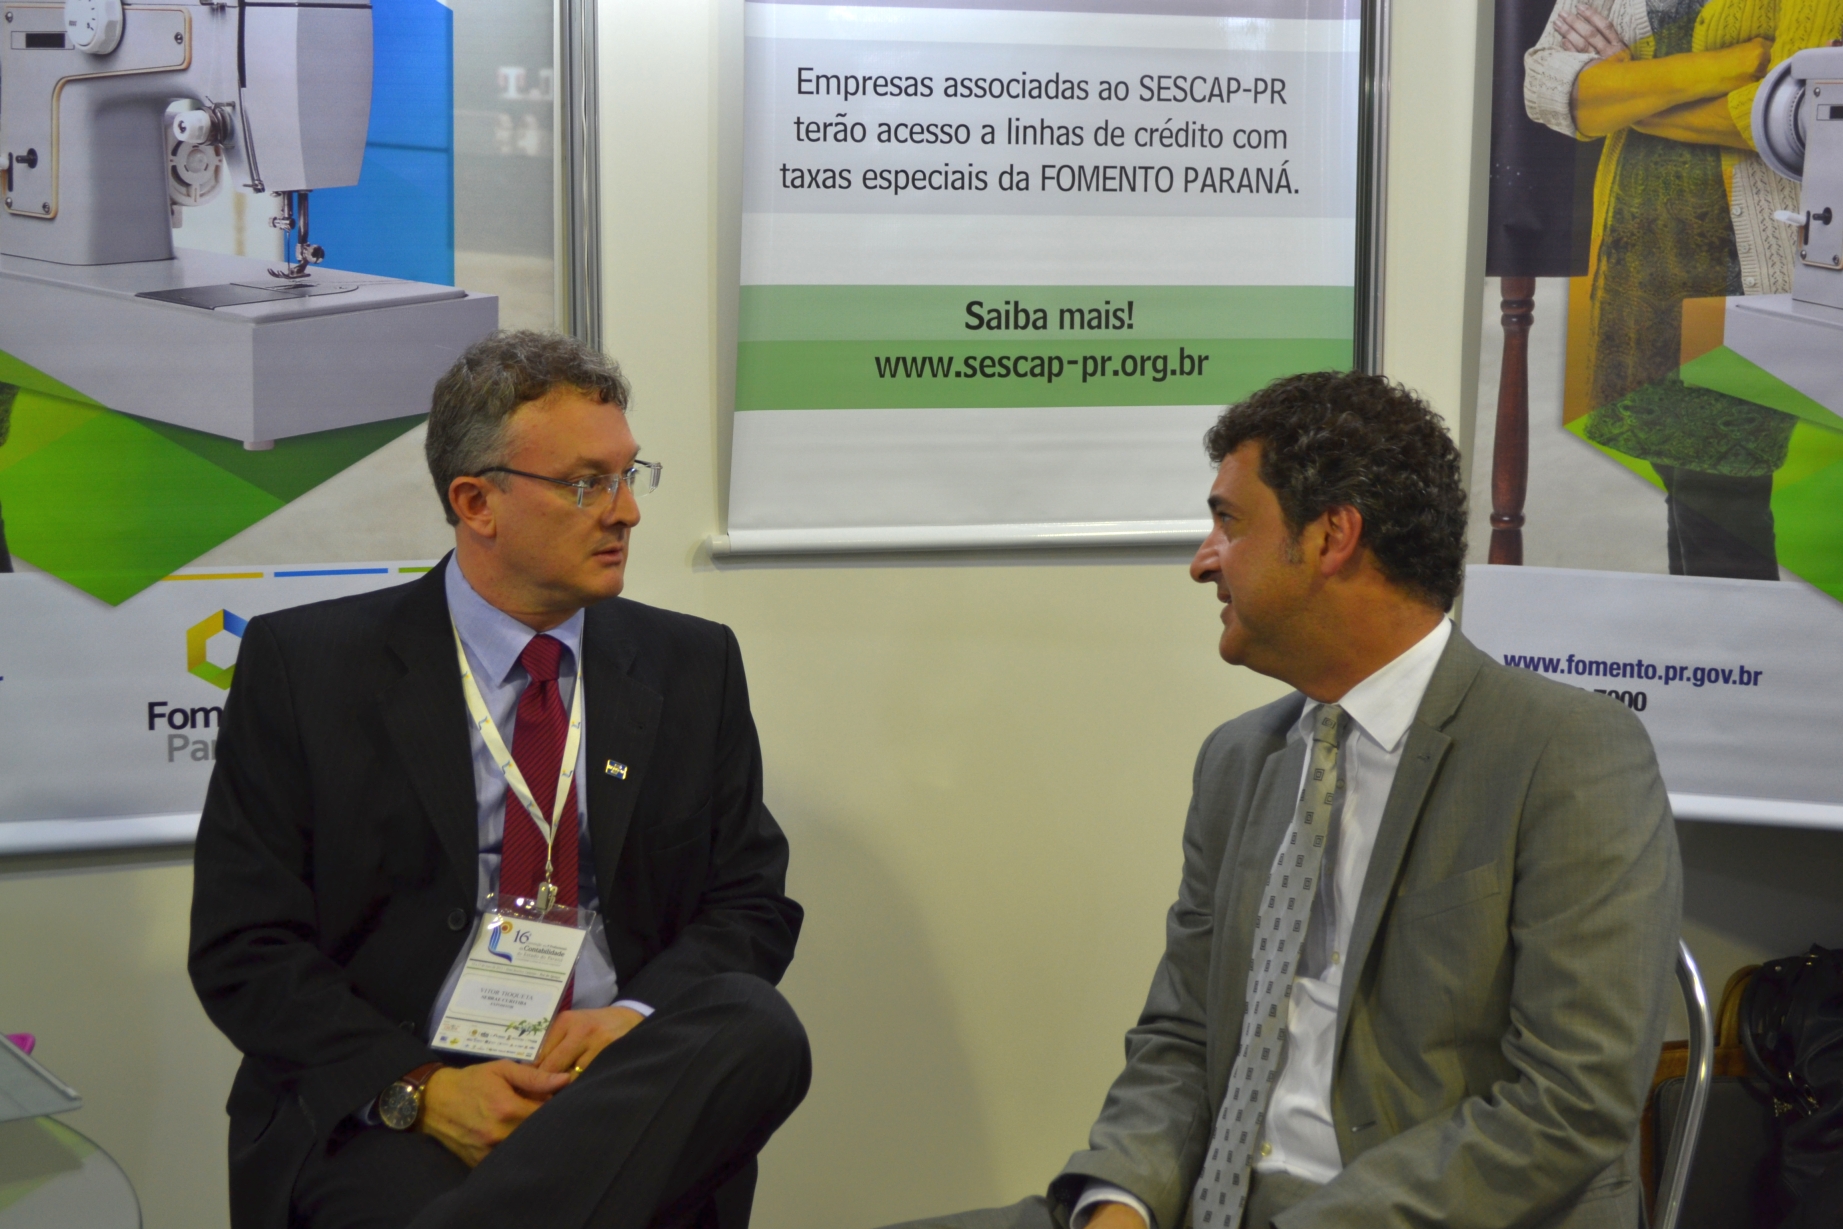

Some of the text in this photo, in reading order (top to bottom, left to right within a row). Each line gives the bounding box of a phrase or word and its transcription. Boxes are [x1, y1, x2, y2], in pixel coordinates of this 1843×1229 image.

[797, 66, 1288, 105] Empresas associadas ao SESCAP-PR
[793, 112, 1288, 150] terão acesso a linhas de crédito com
[779, 159, 1300, 196] taxas especiais da FOMENTO PARANÁ.
[964, 299, 1134, 331] Saiba mais!
[874, 346, 1210, 384] www.sescap-pr.org.br
[1503, 653, 1764, 688] www.fomento.pr.gov.br
